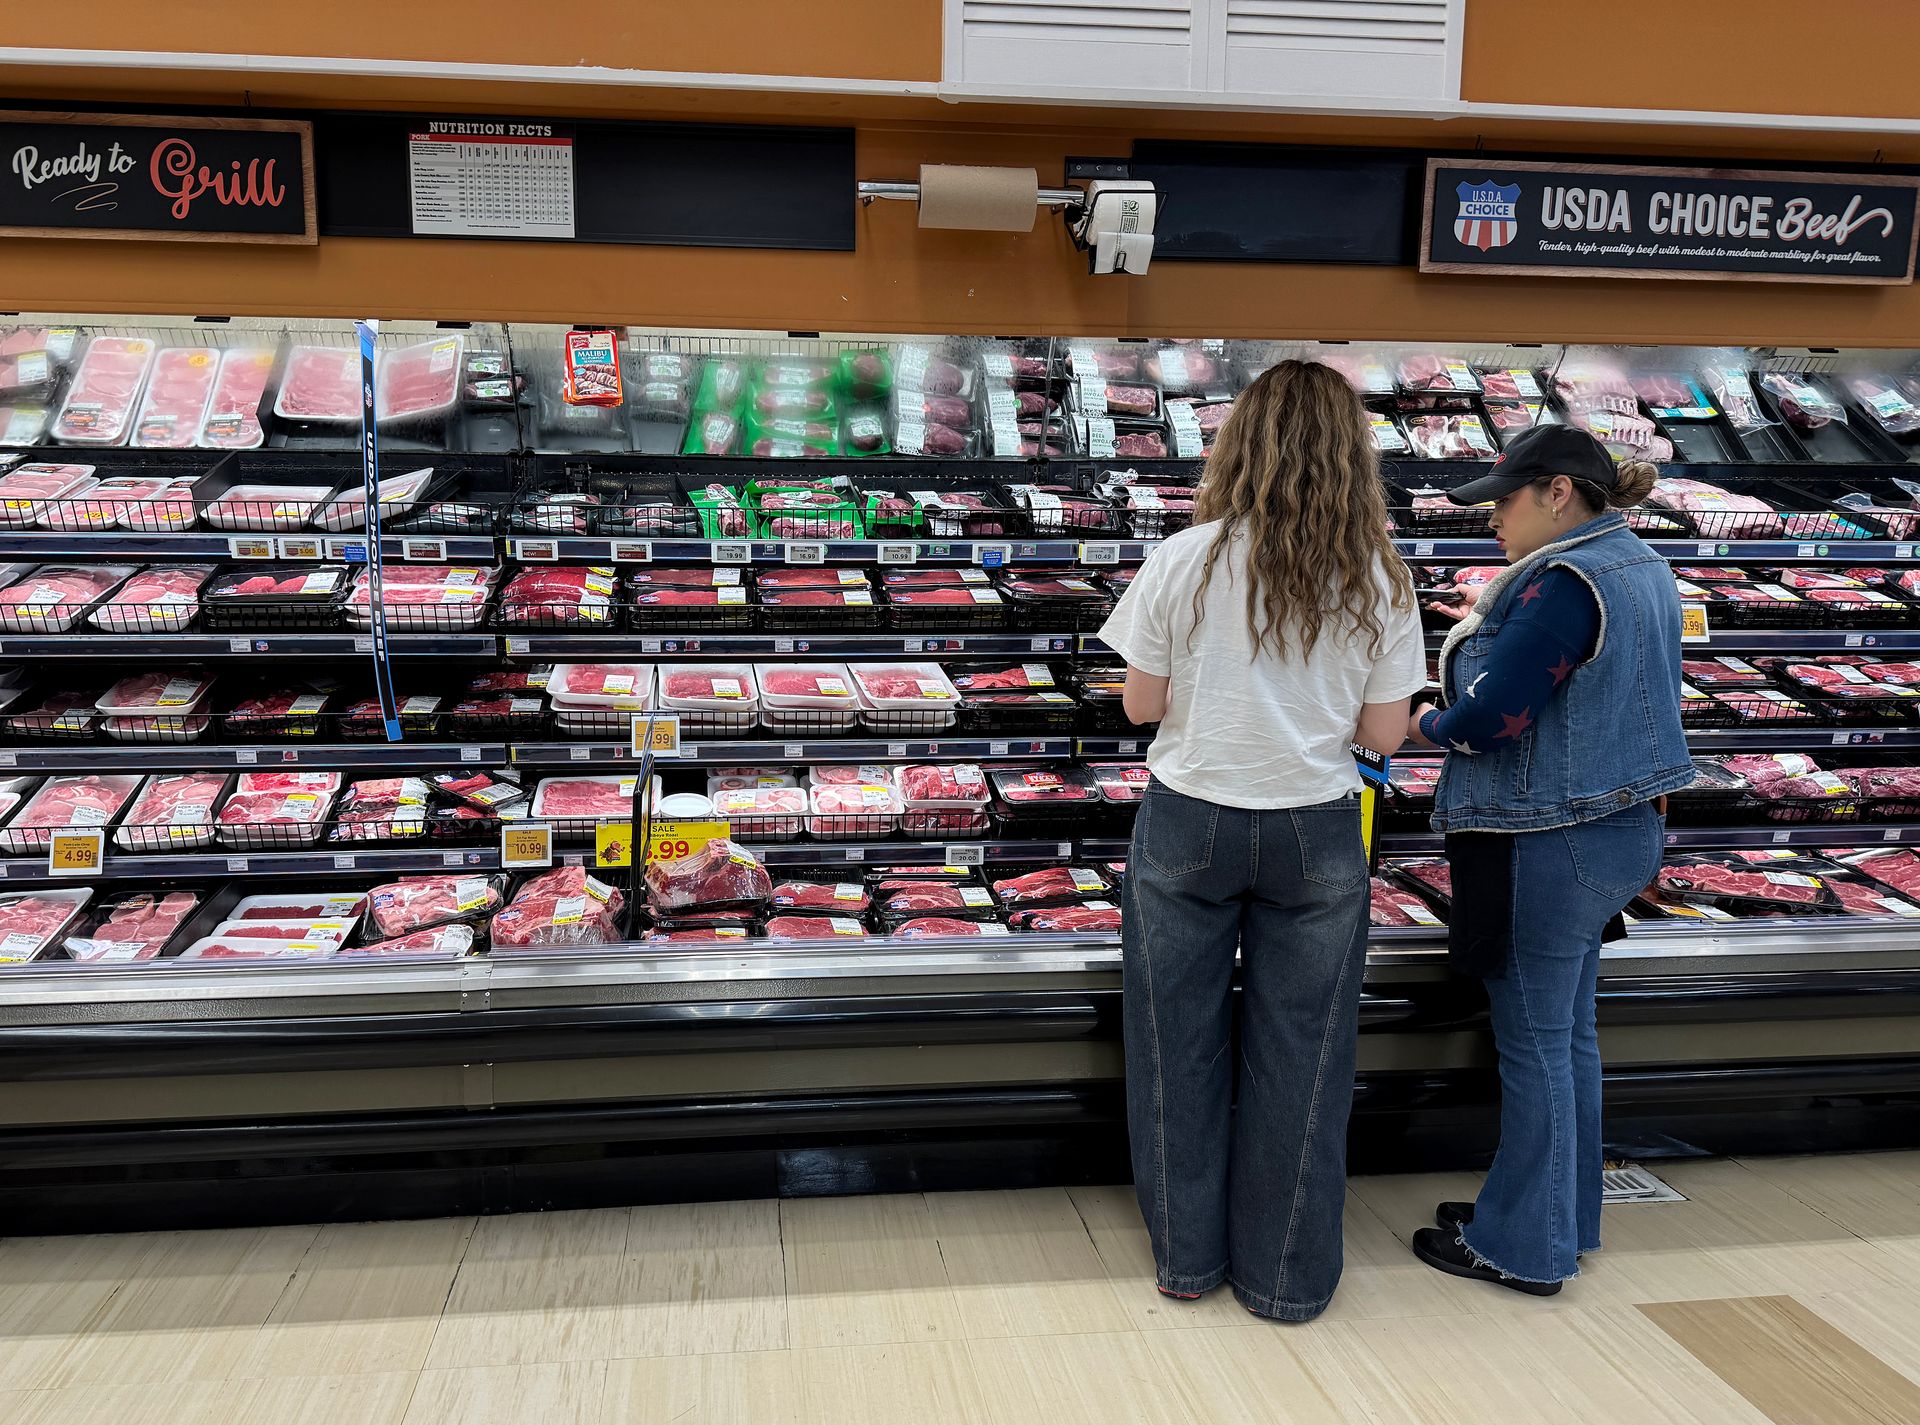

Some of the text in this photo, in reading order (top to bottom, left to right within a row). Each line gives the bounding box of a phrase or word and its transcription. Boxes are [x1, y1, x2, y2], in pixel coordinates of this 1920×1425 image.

[429, 121, 552, 137] NUTRITION FACTS
[12, 141, 136, 190] Ready to
[150, 138, 285, 219] Grill
[1472, 190, 1504, 203] U.S.D.A.
[1465, 204, 1509, 216] CHOICE
[1541, 186, 1773, 239] USDA CHOICE
[1776, 194, 1894, 246] Beef
[1538, 239, 1881, 264] Tender, high-quality beef with modest to moderate marbling for great flavor.
[367, 431, 385, 662] USDA CHOICE BEEF
[1365, 748, 1380, 763] BEEF
[65, 850, 92, 861] 4.99
[516, 843, 541, 854] 10.99
